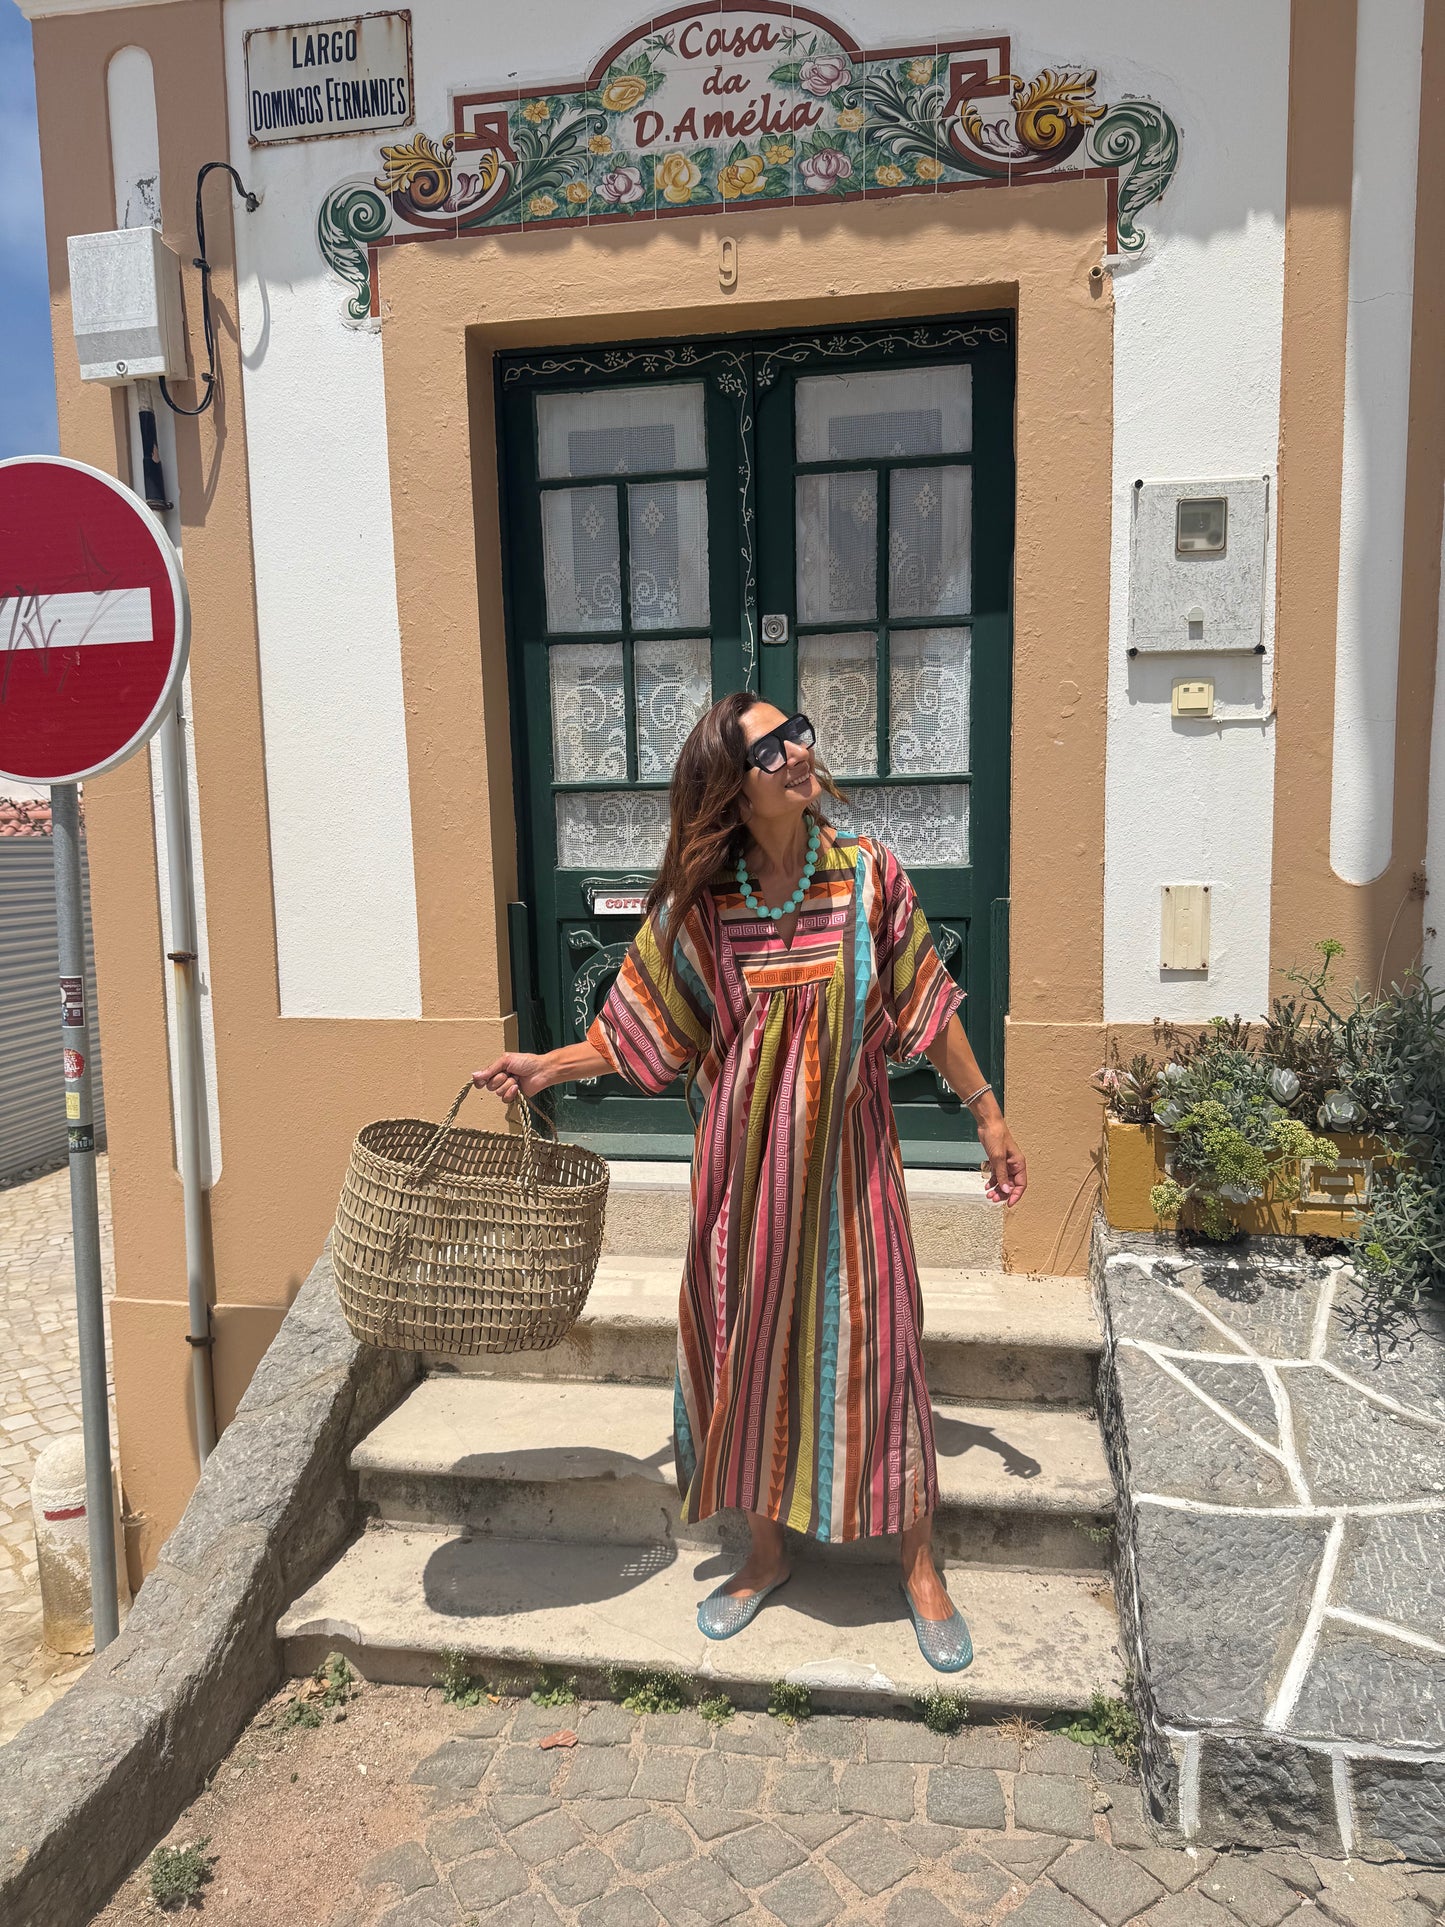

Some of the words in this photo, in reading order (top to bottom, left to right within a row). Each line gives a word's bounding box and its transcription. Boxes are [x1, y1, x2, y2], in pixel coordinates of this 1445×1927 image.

[292, 29, 357, 69] LARGO
[678, 21, 780, 60] Casa
[702, 65, 751, 96] da
[252, 84, 324, 132] DOMINGOS
[325, 77, 407, 122] FERNANDES
[719, 236, 737, 286] 9
